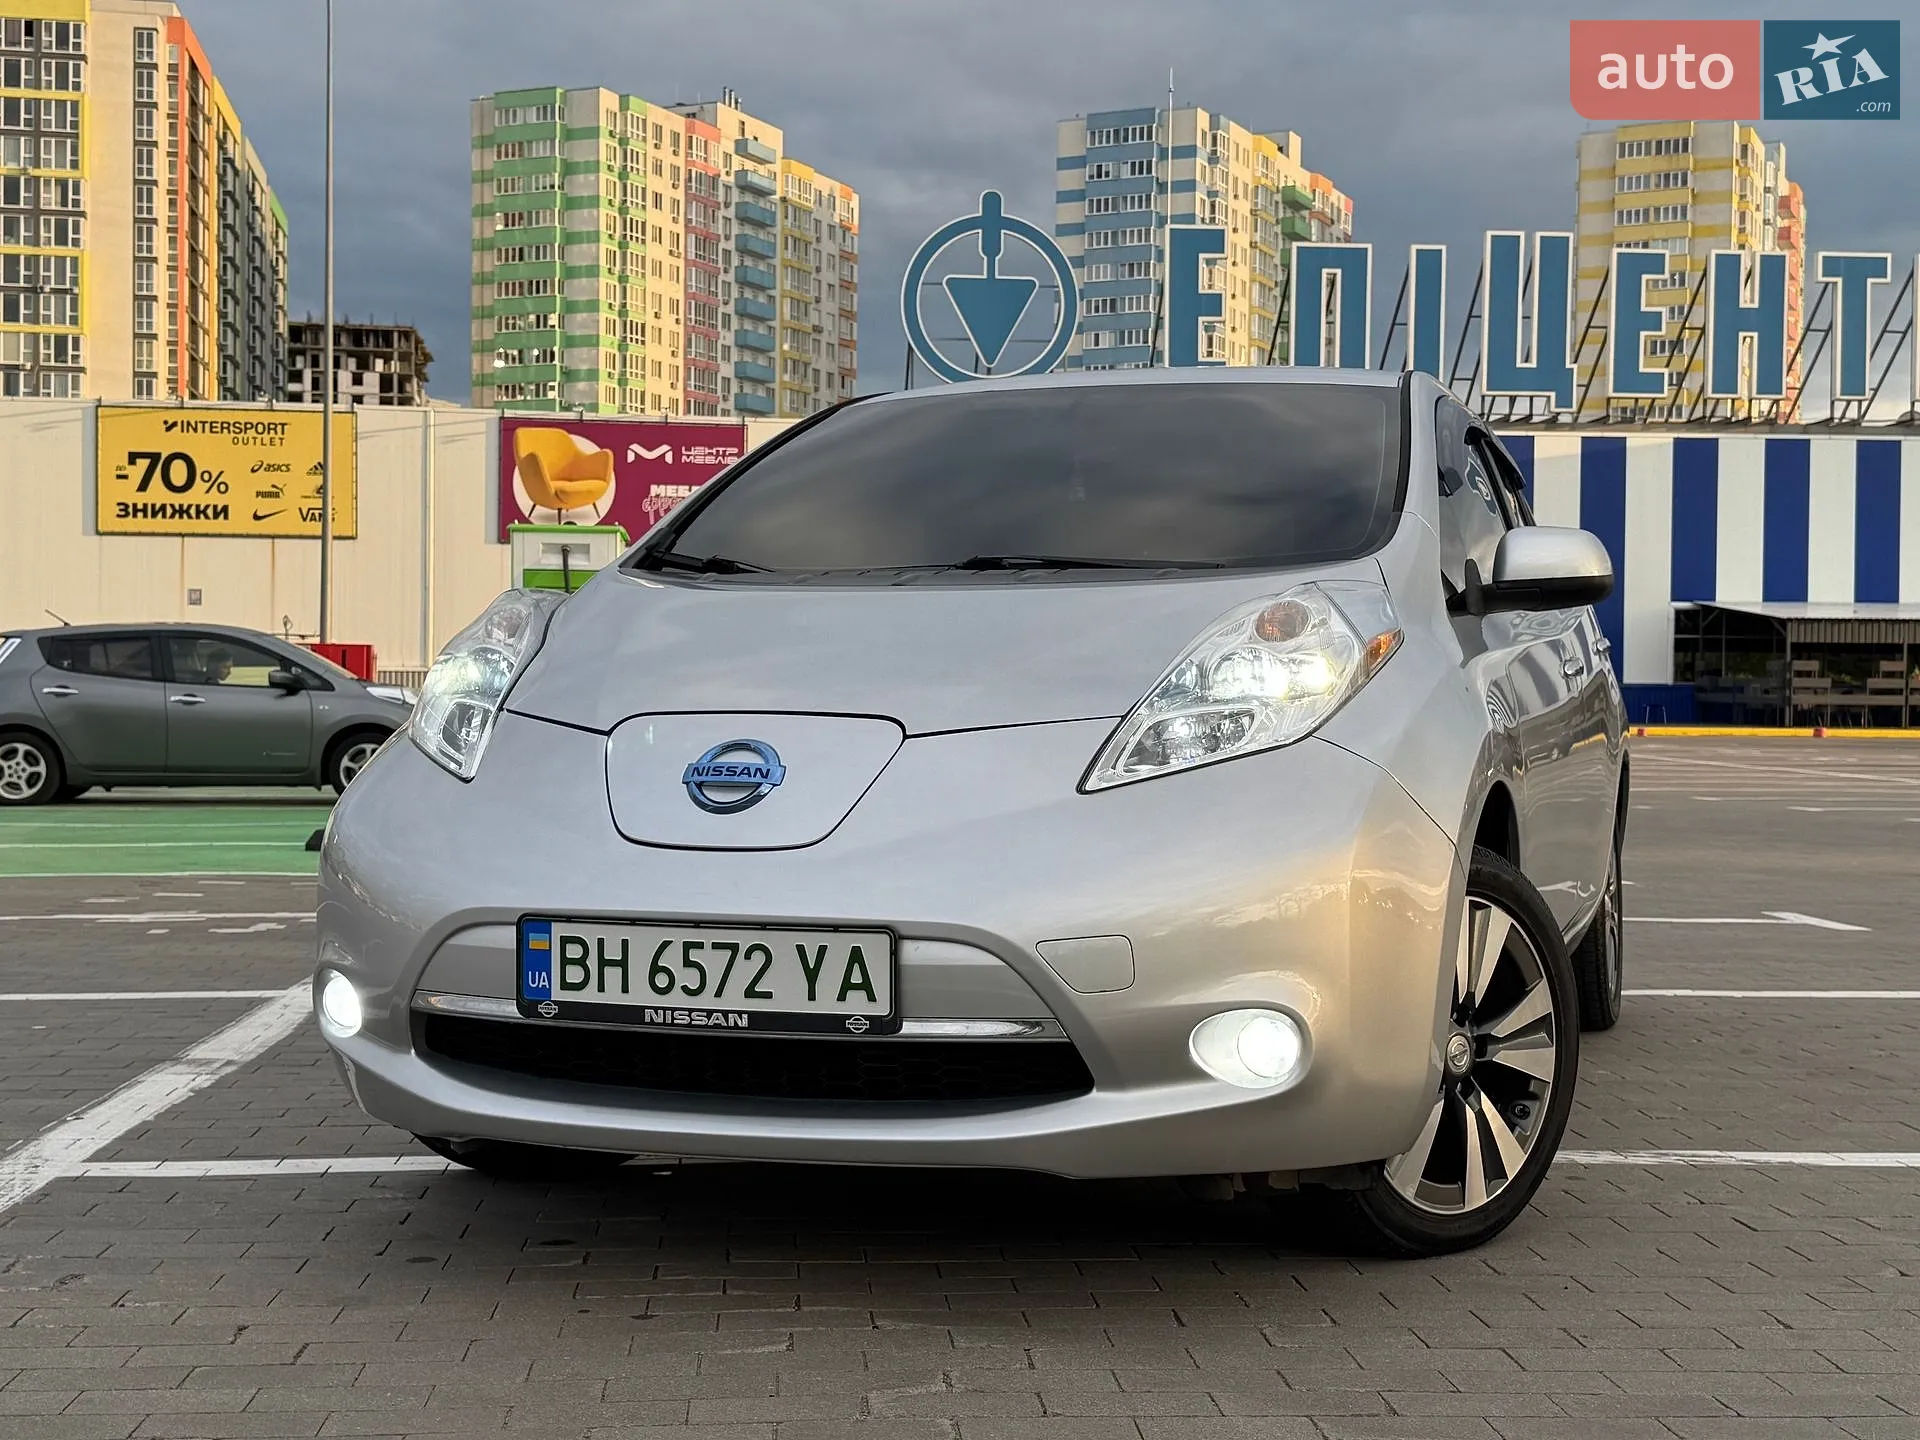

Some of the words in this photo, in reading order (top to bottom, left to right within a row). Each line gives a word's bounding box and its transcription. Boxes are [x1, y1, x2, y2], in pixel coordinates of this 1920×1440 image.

[1164, 224, 1920, 412] ЕПІЦЕНТ
[180, 419, 288, 436] INTERSPORT
[231, 436, 286, 447] OUTLET
[681, 446, 738, 456] ЦЕНТР
[115, 451, 229, 495] -70%
[298, 506, 335, 522] VA
[690, 765, 771, 780] NISSAN
[559, 935, 630, 994] BH
[647, 939, 774, 1000] 6572
[795, 944, 878, 1003] YA
[528, 971, 549, 990] UA
[644, 1008, 749, 1029] NISSAN
